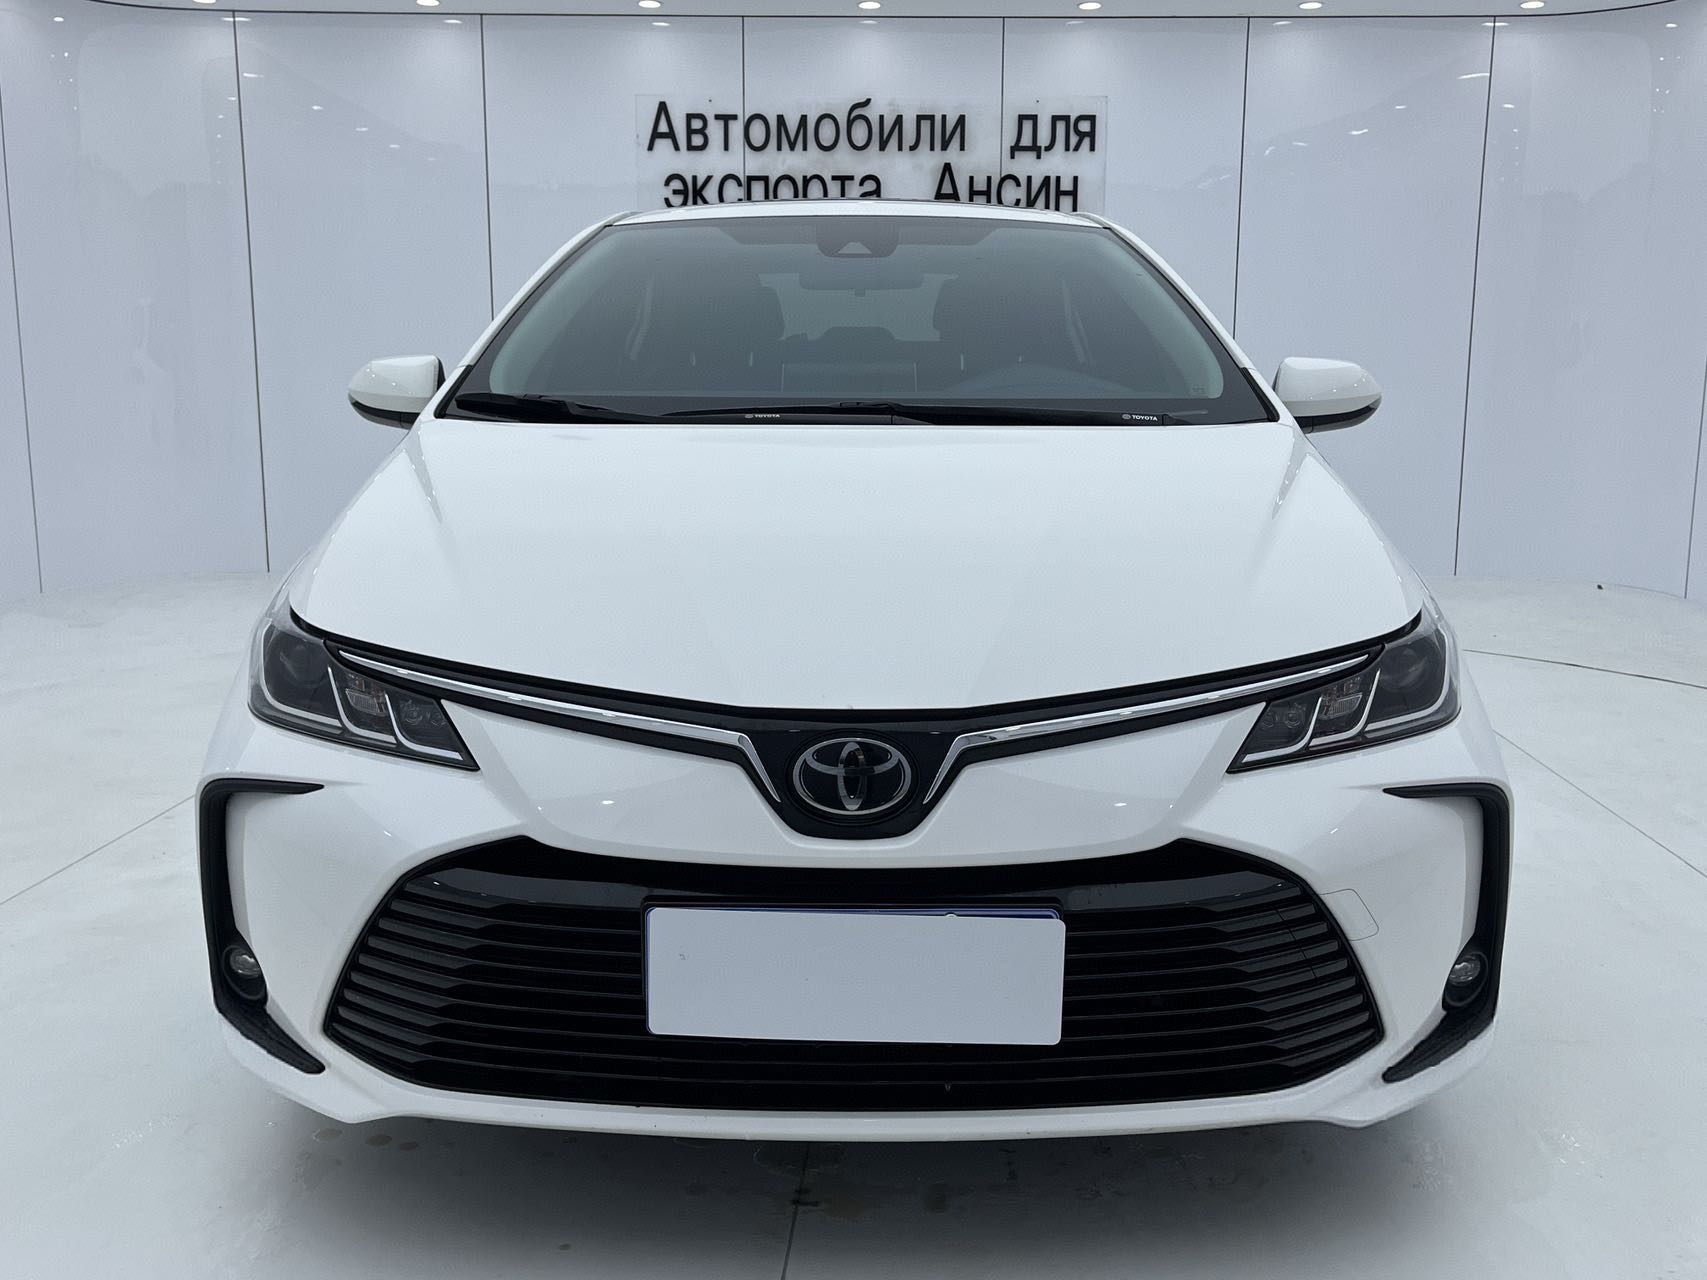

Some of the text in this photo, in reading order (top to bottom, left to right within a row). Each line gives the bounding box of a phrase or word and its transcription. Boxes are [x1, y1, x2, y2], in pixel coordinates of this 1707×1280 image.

[647, 98, 1097, 160] Автомобили для
[933, 162, 1079, 212] Ансин
